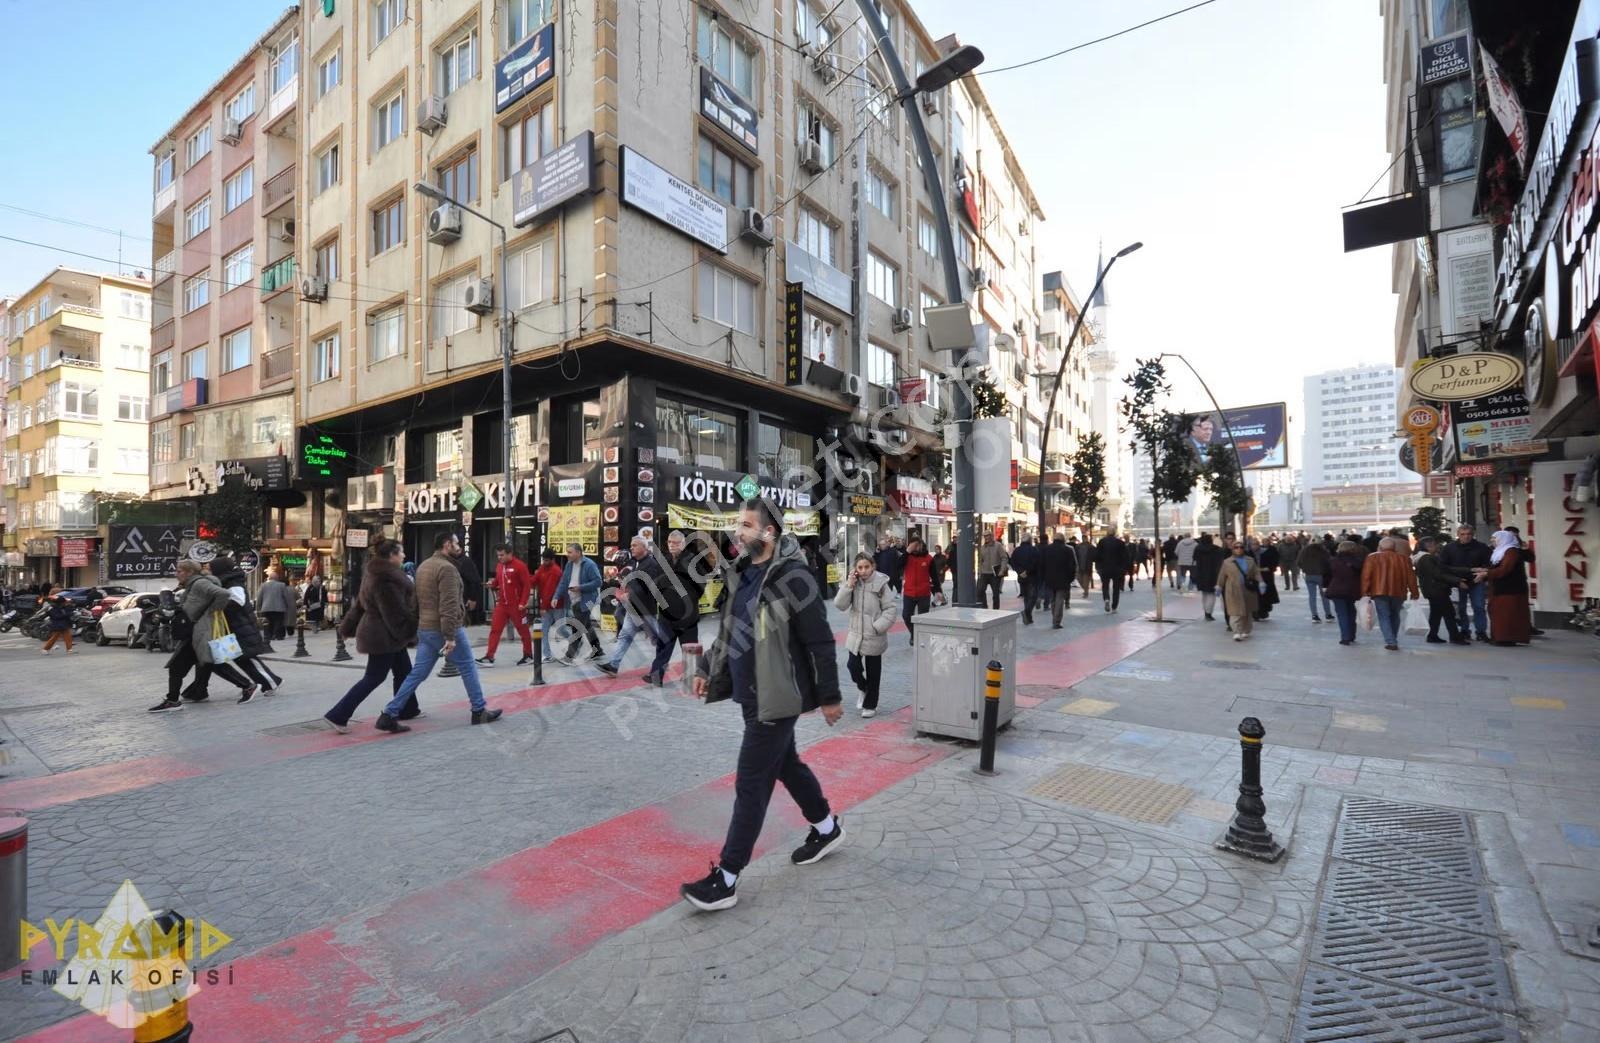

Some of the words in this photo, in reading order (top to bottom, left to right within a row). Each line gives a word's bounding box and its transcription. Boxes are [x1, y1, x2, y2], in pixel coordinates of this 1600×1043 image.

[1428, 57, 1465, 73] HUKUK
[1432, 53, 1458, 66] DİCLE
[1425, 63, 1468, 80] BÜROSU
[668, 177, 694, 198] KENTSEL
[789, 302, 797, 380] KAYNAK
[1441, 365, 1455, 379] D
[1459, 366, 1471, 377] &
[1474, 360, 1488, 375] P
[1430, 375, 1501, 394] perfumum
[1466, 409, 1489, 419] 0505
[1491, 408, 1508, 416] 668
[408, 484, 458, 514] KÖFTE
[679, 472, 735, 504] KÖFTE
[761, 485, 797, 509] KEYFİ
[584, 543, 596, 553] 70
[116, 563, 161, 572] PROJE
[168, 563, 177, 571] A
